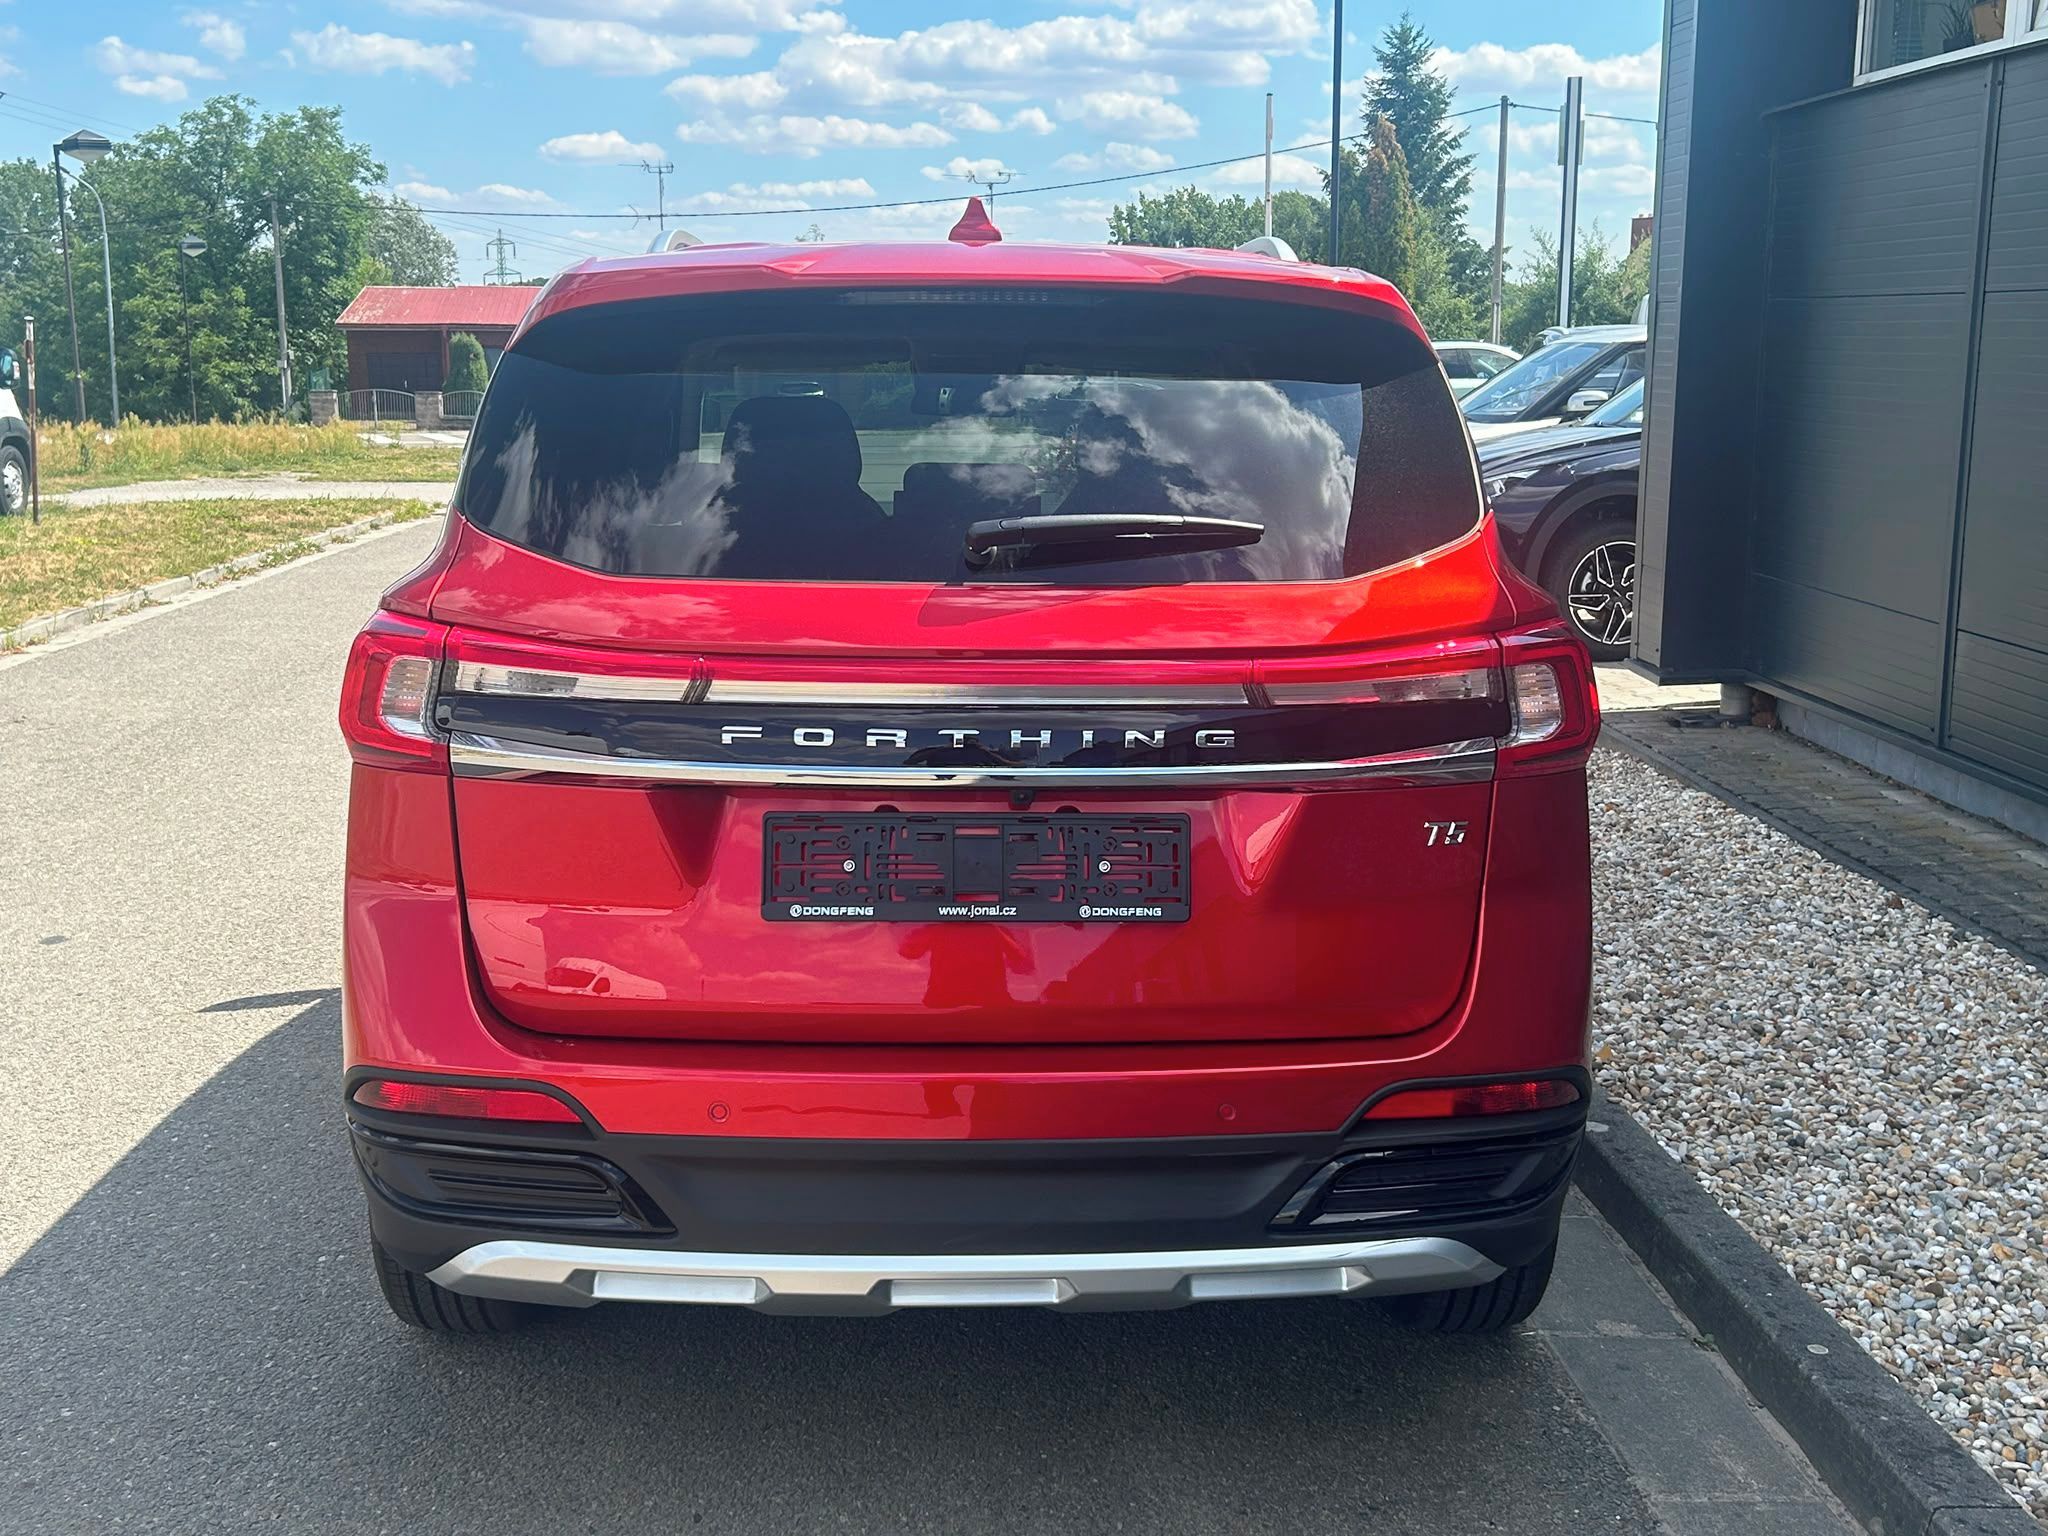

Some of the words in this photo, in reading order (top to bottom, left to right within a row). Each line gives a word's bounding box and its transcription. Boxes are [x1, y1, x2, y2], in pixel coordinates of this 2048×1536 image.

[721, 725, 1235, 749] FORTHING
[1423, 821, 1469, 846] T5
[802, 906, 875, 916] DONGFENG
[938, 904, 1017, 918] www.jonal.cz
[1092, 907, 1162, 917] DONGFENG
